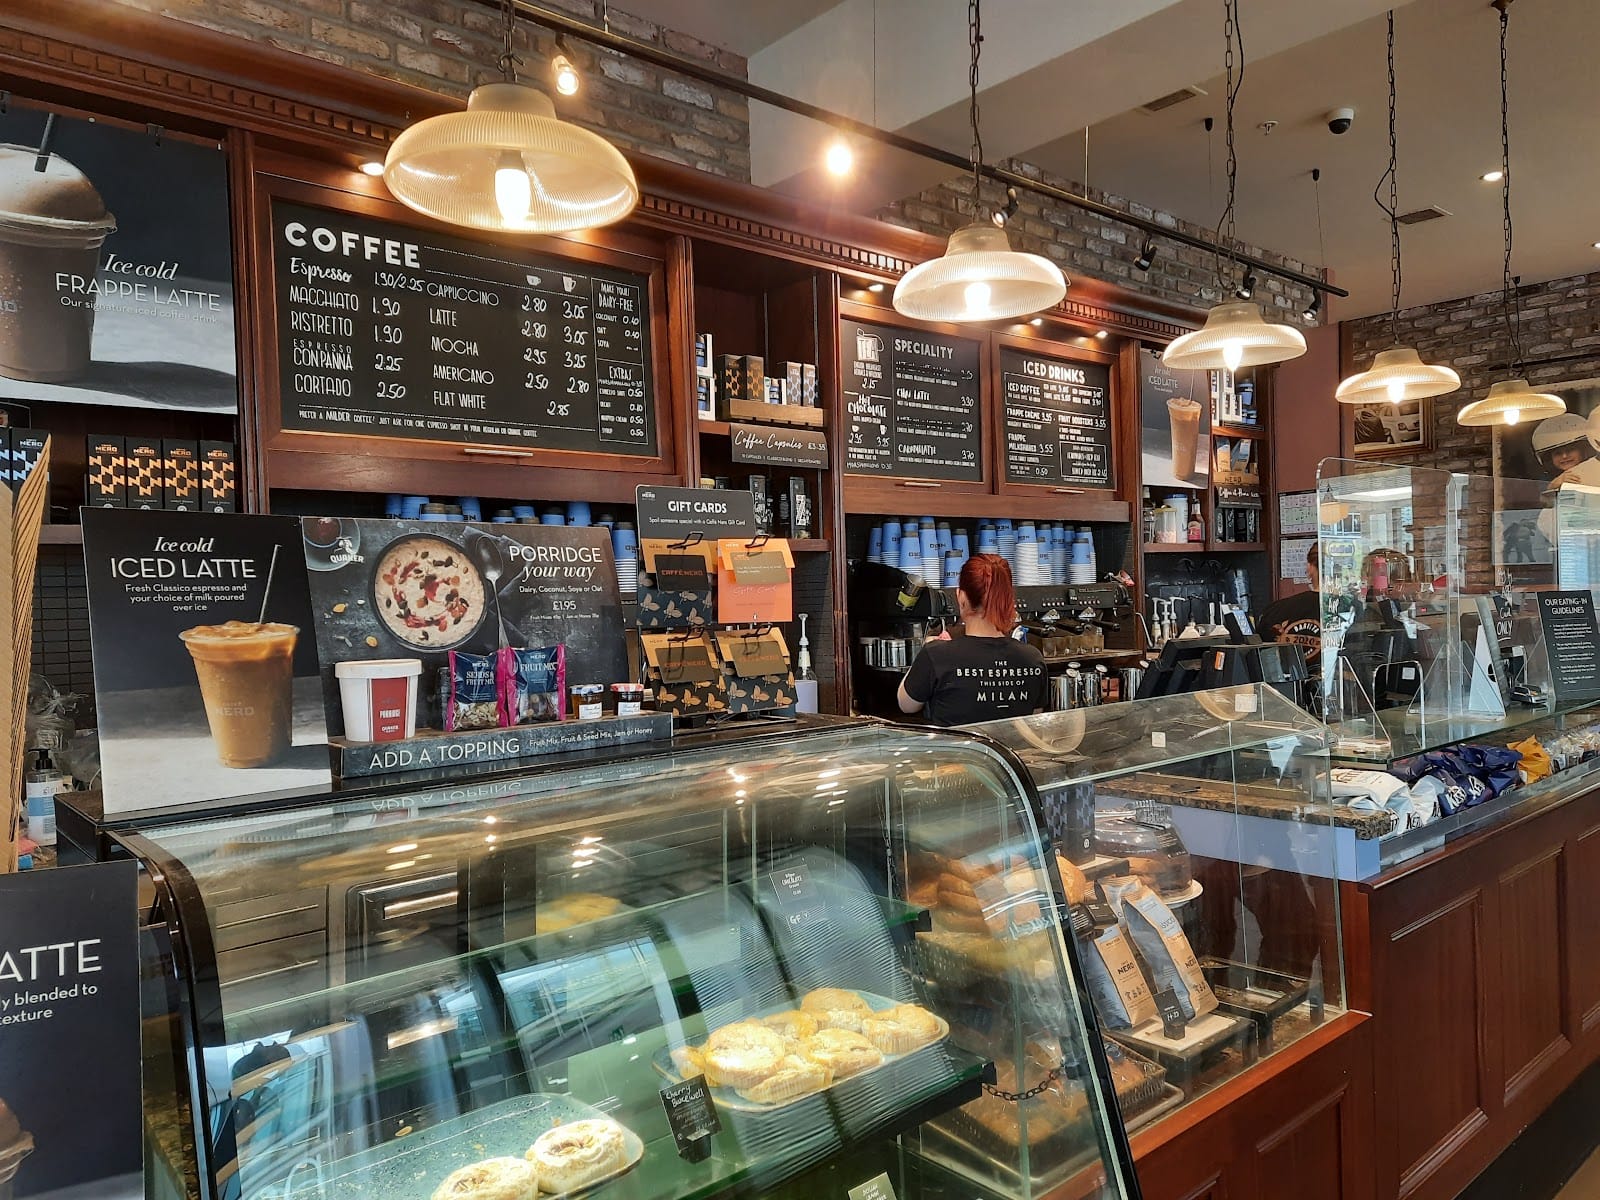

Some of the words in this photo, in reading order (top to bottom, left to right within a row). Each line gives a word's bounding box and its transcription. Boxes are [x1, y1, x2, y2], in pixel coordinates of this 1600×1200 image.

[285, 222, 420, 269] COFFEE
[104, 253, 132, 273] Ice
[135, 260, 179, 281] cold
[290, 257, 353, 284] Espresso
[56, 273, 148, 302] FRAPPE
[153, 286, 223, 312] LATTE
[289, 285, 359, 312] MACCHIATO
[372, 297, 401, 316] 1.90
[427, 282, 499, 306] CAPPUCCINO
[521, 295, 547, 312] 2.80
[562, 301, 588, 319] 3.05
[60, 296, 82, 308] Our
[85, 300, 133, 313] signature
[599, 292, 634, 312] DAIRY-FREE
[291, 310, 353, 337] RISTRETTO
[374, 325, 402, 344] 1.90
[429, 308, 457, 327] LATTE
[521, 320, 547, 338] 2.80
[563, 326, 588, 345] 3.05
[293, 339, 352, 354] ESPRESSO
[431, 336, 479, 356] MOCHA
[894, 338, 953, 359] SPECIALITY
[433, 364, 494, 385] AMERICANO
[567, 377, 590, 393] 2.80
[609, 366, 632, 380] EXTRAS
[1023, 360, 1047, 376] ICED
[1048, 365, 1085, 384] DRINKS
[294, 374, 352, 397] CORTADO
[1008, 382, 1019, 392] ICED
[1020, 385, 1040, 395] COFFEE
[433, 390, 455, 407] FLAT
[458, 393, 487, 410] WHITE
[299, 411, 316, 419] PREFER
[326, 411, 351, 422] MILDER
[404, 419, 414, 427] FOR
[735, 430, 764, 449] Coffee
[767, 433, 803, 451] Capsules
[668, 501, 691, 512] GIFT
[694, 502, 727, 513] CARDS
[154, 536, 178, 552] Ice
[179, 537, 215, 553] cold
[330, 555, 364, 563] QUAKER
[509, 545, 603, 563] PORRIDGE
[110, 557, 176, 578] ICED
[181, 558, 257, 578] LATTE
[522, 566, 561, 582] your
[562, 566, 596, 582] way
[125, 583, 151, 593] Fresh
[153, 583, 191, 593] Classico
[192, 585, 230, 595] espresso
[231, 583, 247, 592] and
[520, 586, 537, 594] Dairy,
[568, 585, 582, 594] Soya
[130, 594, 151, 604] your
[152, 593, 183, 602] choice
[183, 592, 194, 601] of
[194, 592, 213, 601] milk
[214, 593, 245, 602] poured
[553, 600, 577, 610] £1.95
[1544, 598, 1559, 606] OUR
[1559, 597, 1588, 606] EATING-IN
[173, 604, 193, 612] over
[194, 603, 208, 611] ice
[1551, 606, 1585, 614] GUIDELINES
[520, 663, 542, 672] FRUIT
[543, 662, 557, 671] MIX
[957, 669, 984, 677] BEST
[988, 668, 1041, 677] ESPRESSO
[977, 691, 1028, 702] MILAN
[369, 751, 412, 770] ADD
[419, 748, 432, 764] A
[437, 738, 520, 761] TOPPING
[529, 739, 545, 747] Fruit
[14, 983, 78, 1006] blended
[81, 983, 98, 995] to
[666, 1084, 691, 1099] Cherry
